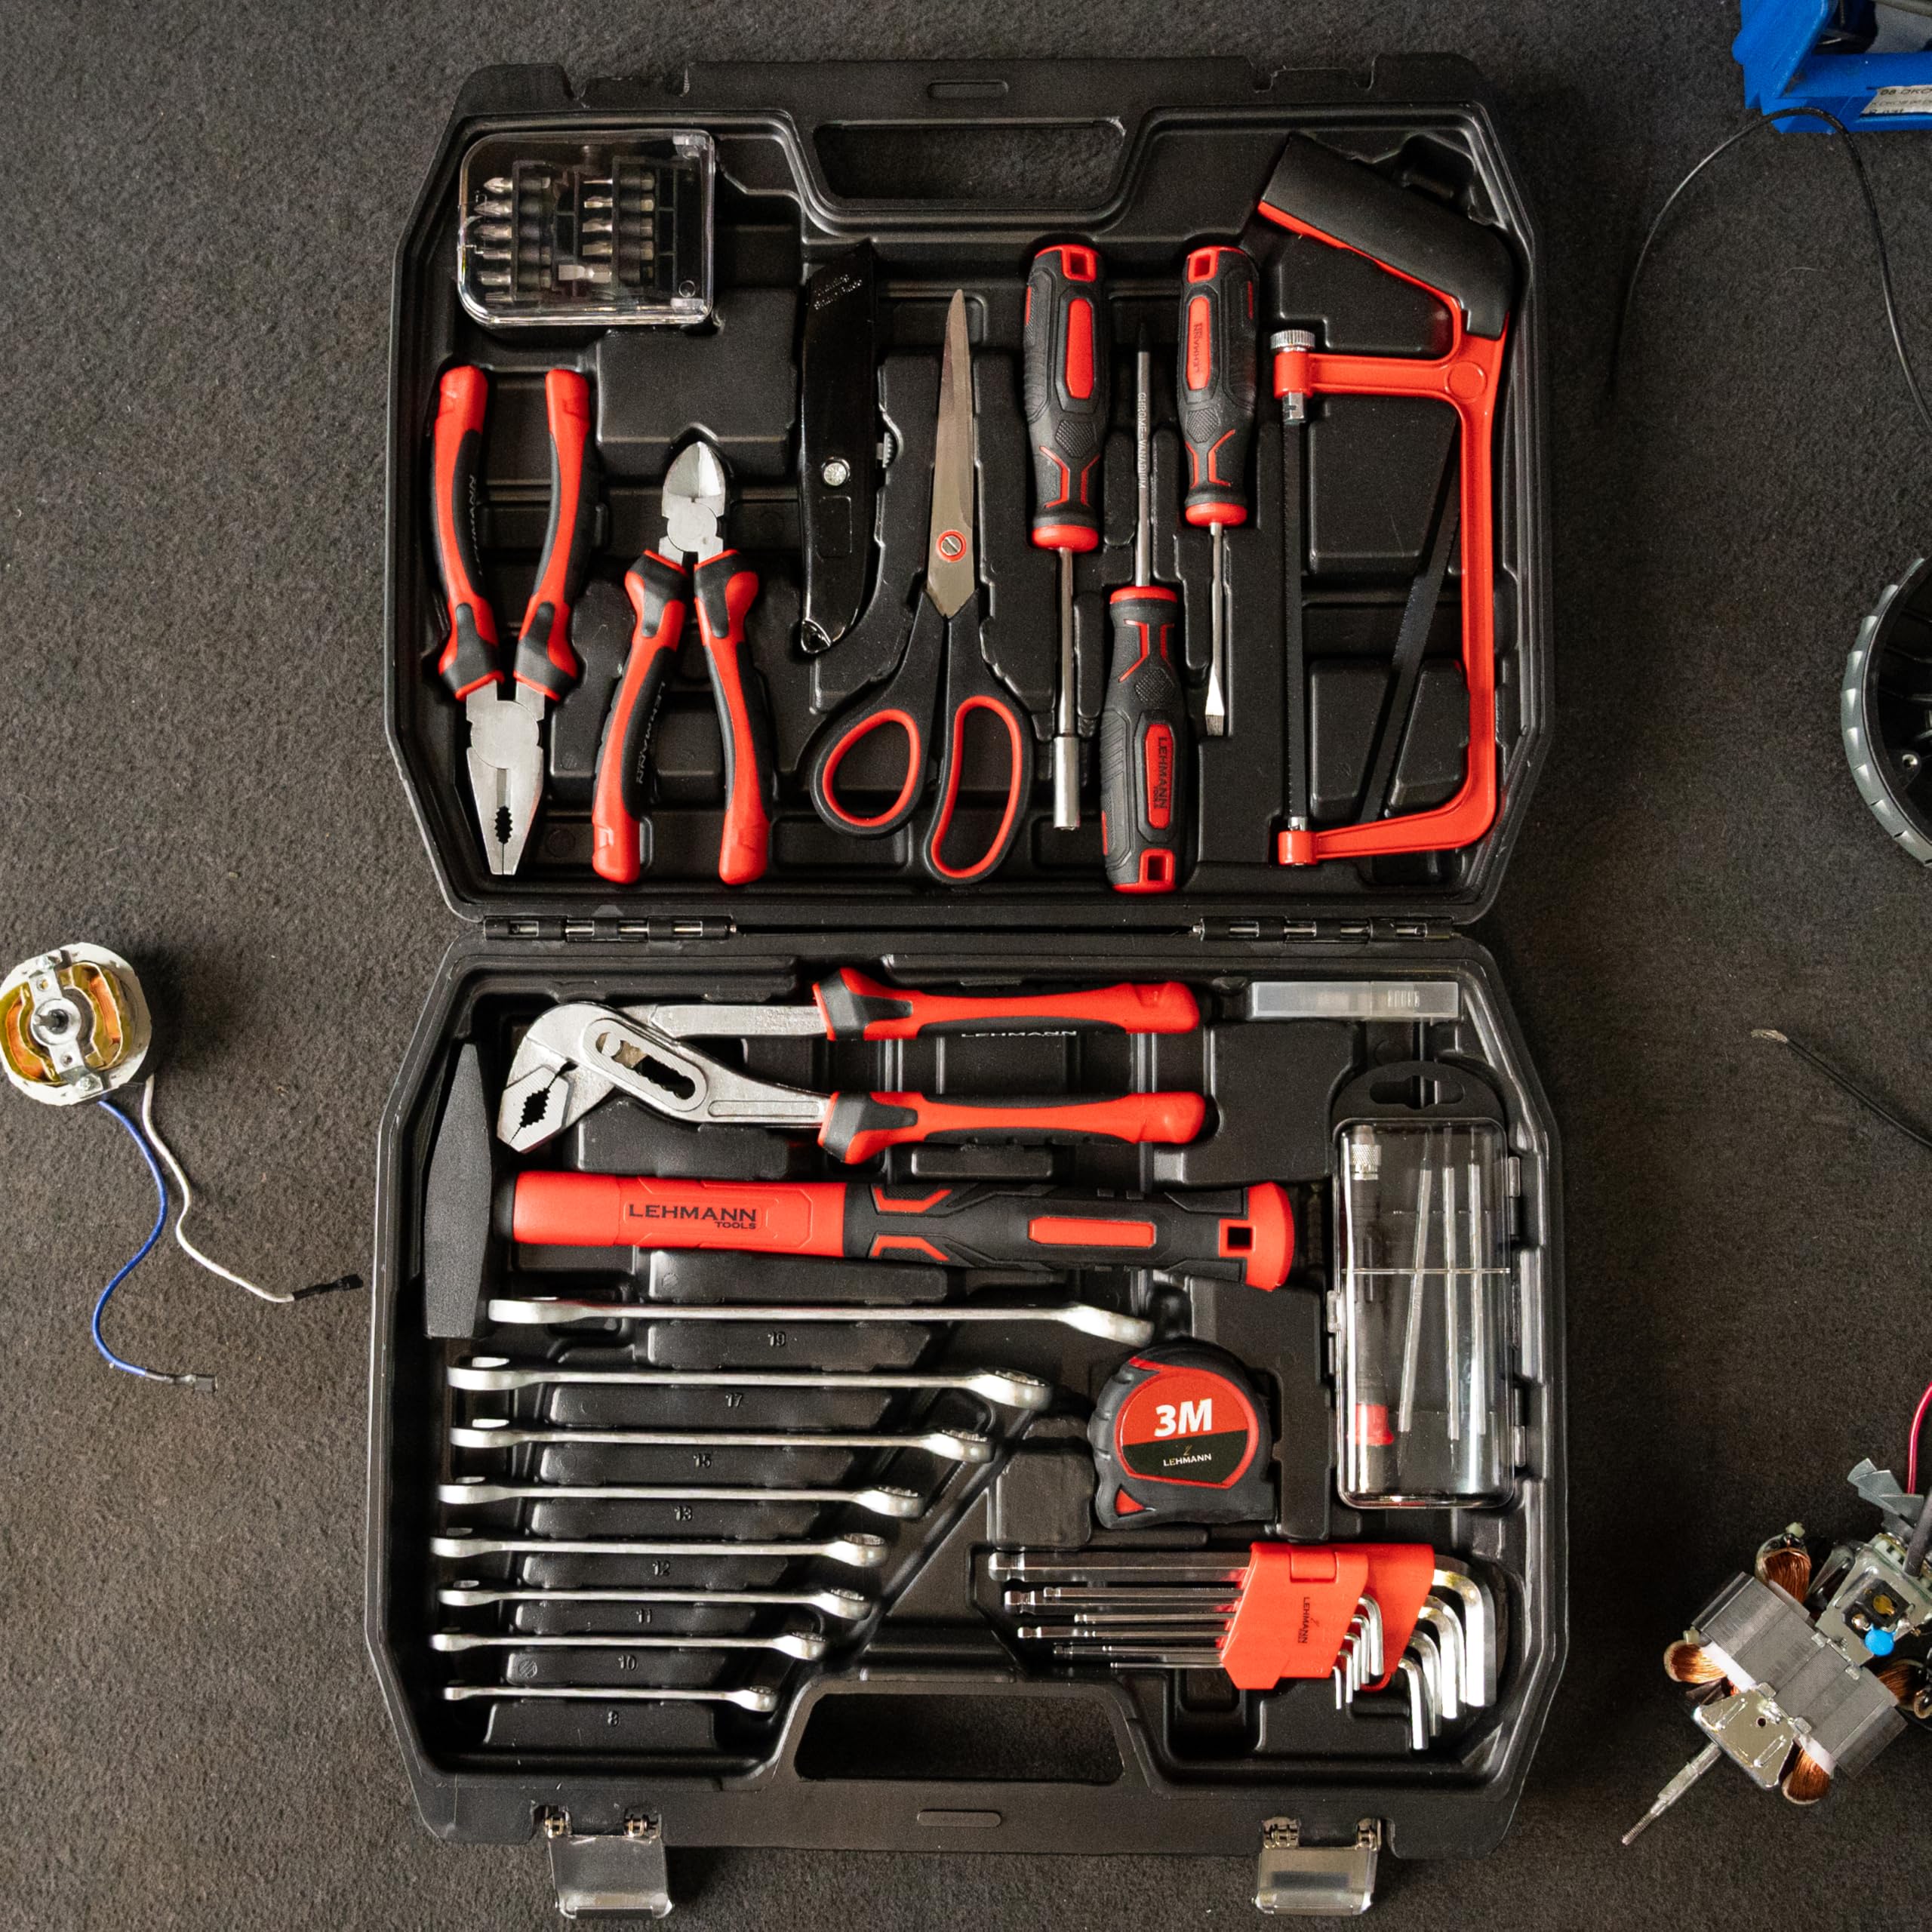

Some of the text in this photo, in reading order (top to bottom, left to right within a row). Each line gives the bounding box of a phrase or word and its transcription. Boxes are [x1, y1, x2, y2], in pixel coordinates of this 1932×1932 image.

[469, 474, 483, 576] MANN
[1158, 737, 1168, 809] LEHMANN
[629, 1204, 756, 1222] LEHMANN
[714, 1220, 756, 1229] TOOLS
[768, 1332, 786, 1346] 19
[725, 1393, 743, 1407] 17
[1154, 1398, 1212, 1437] 3M
[693, 1454, 711, 1467] 15
[1163, 1453, 1212, 1466] LEHMANN
[674, 1506, 692, 1521] 13
[652, 1561, 670, 1576] 12
[636, 1609, 652, 1623] 11
[1302, 1597, 1310, 1643] LEHMANN
[617, 1655, 637, 1670] 10
[607, 1710, 619, 1726] 8
